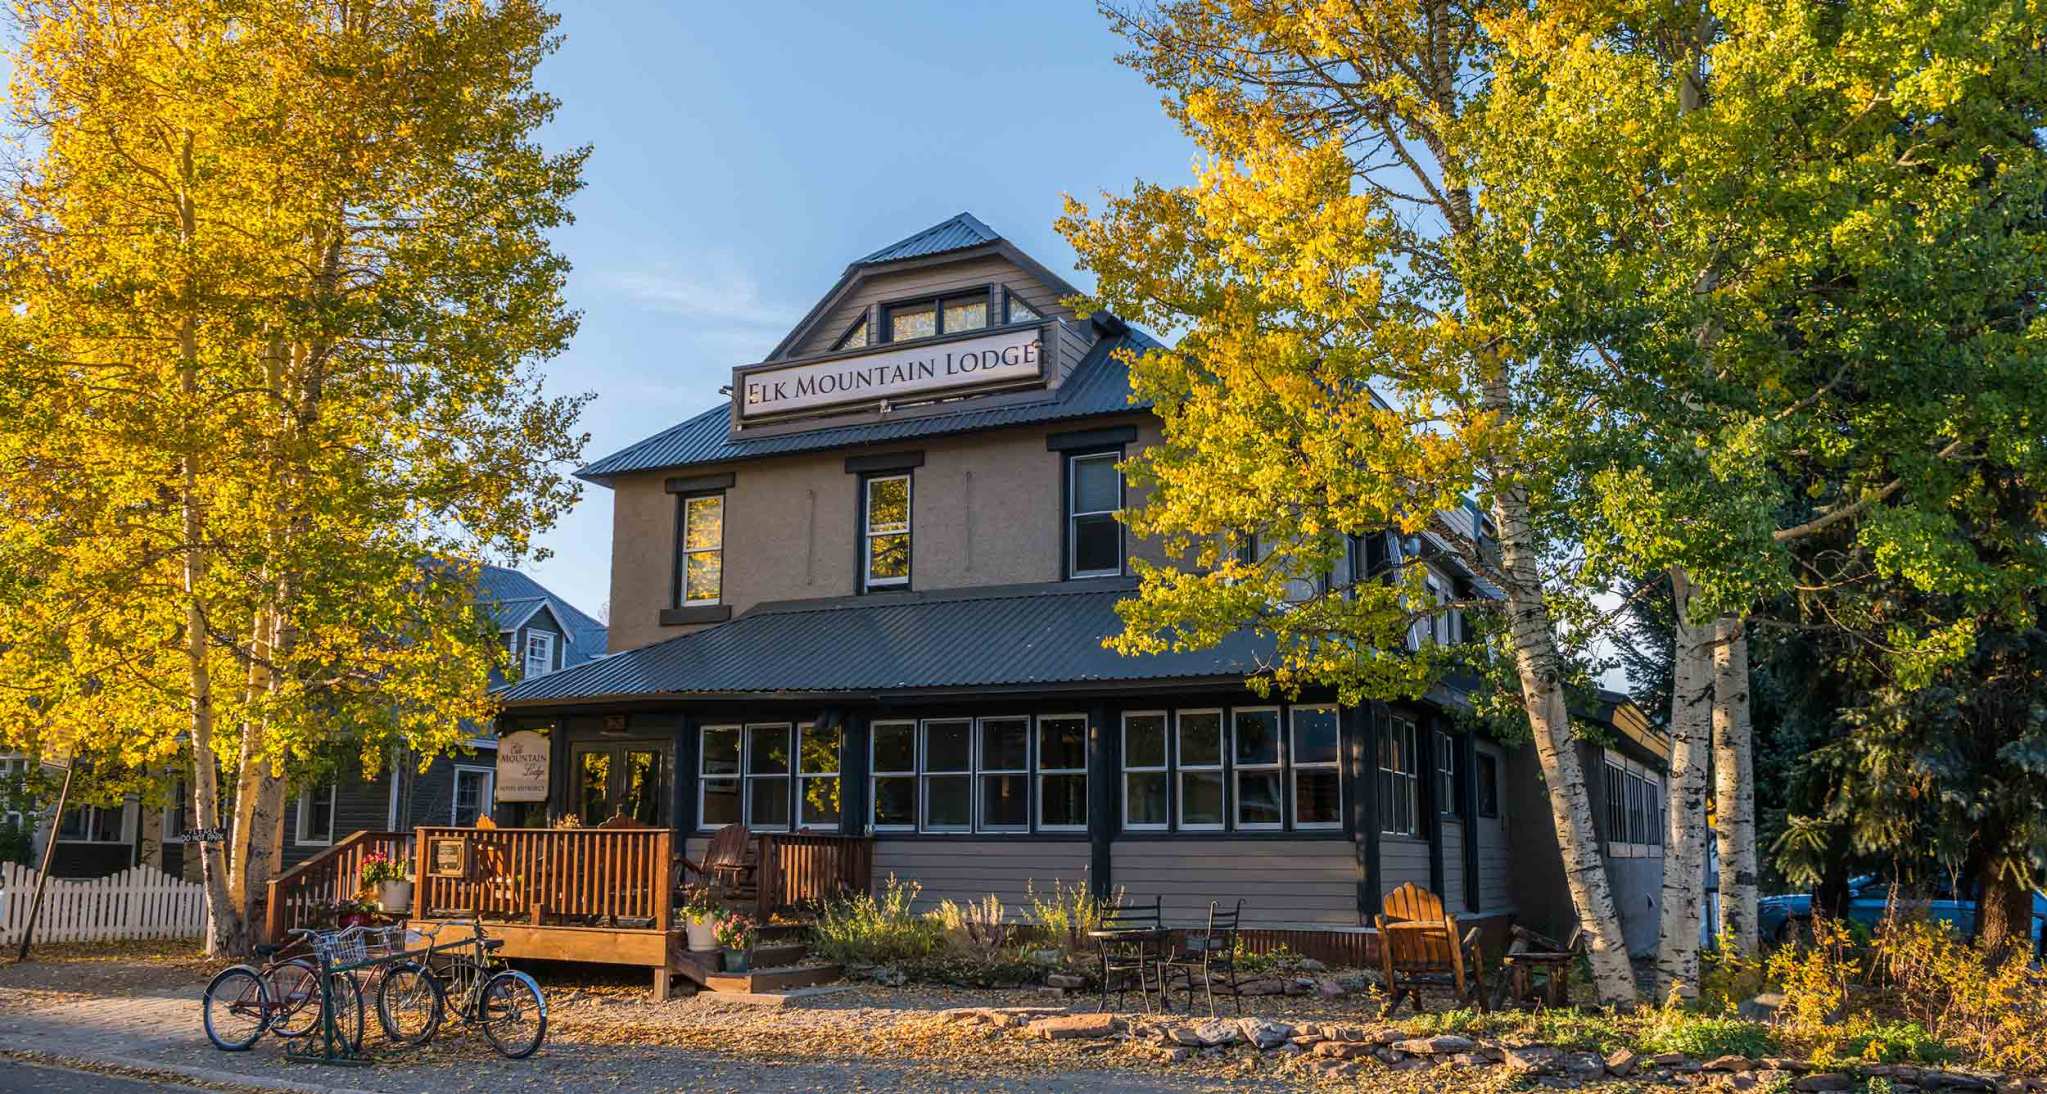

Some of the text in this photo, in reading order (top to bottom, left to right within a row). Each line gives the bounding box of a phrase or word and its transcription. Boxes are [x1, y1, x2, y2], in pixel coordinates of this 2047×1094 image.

[748, 343, 1037, 404] ELK MOUNTAIN LODGE
[501, 752, 547, 763] MOUNTAIN
